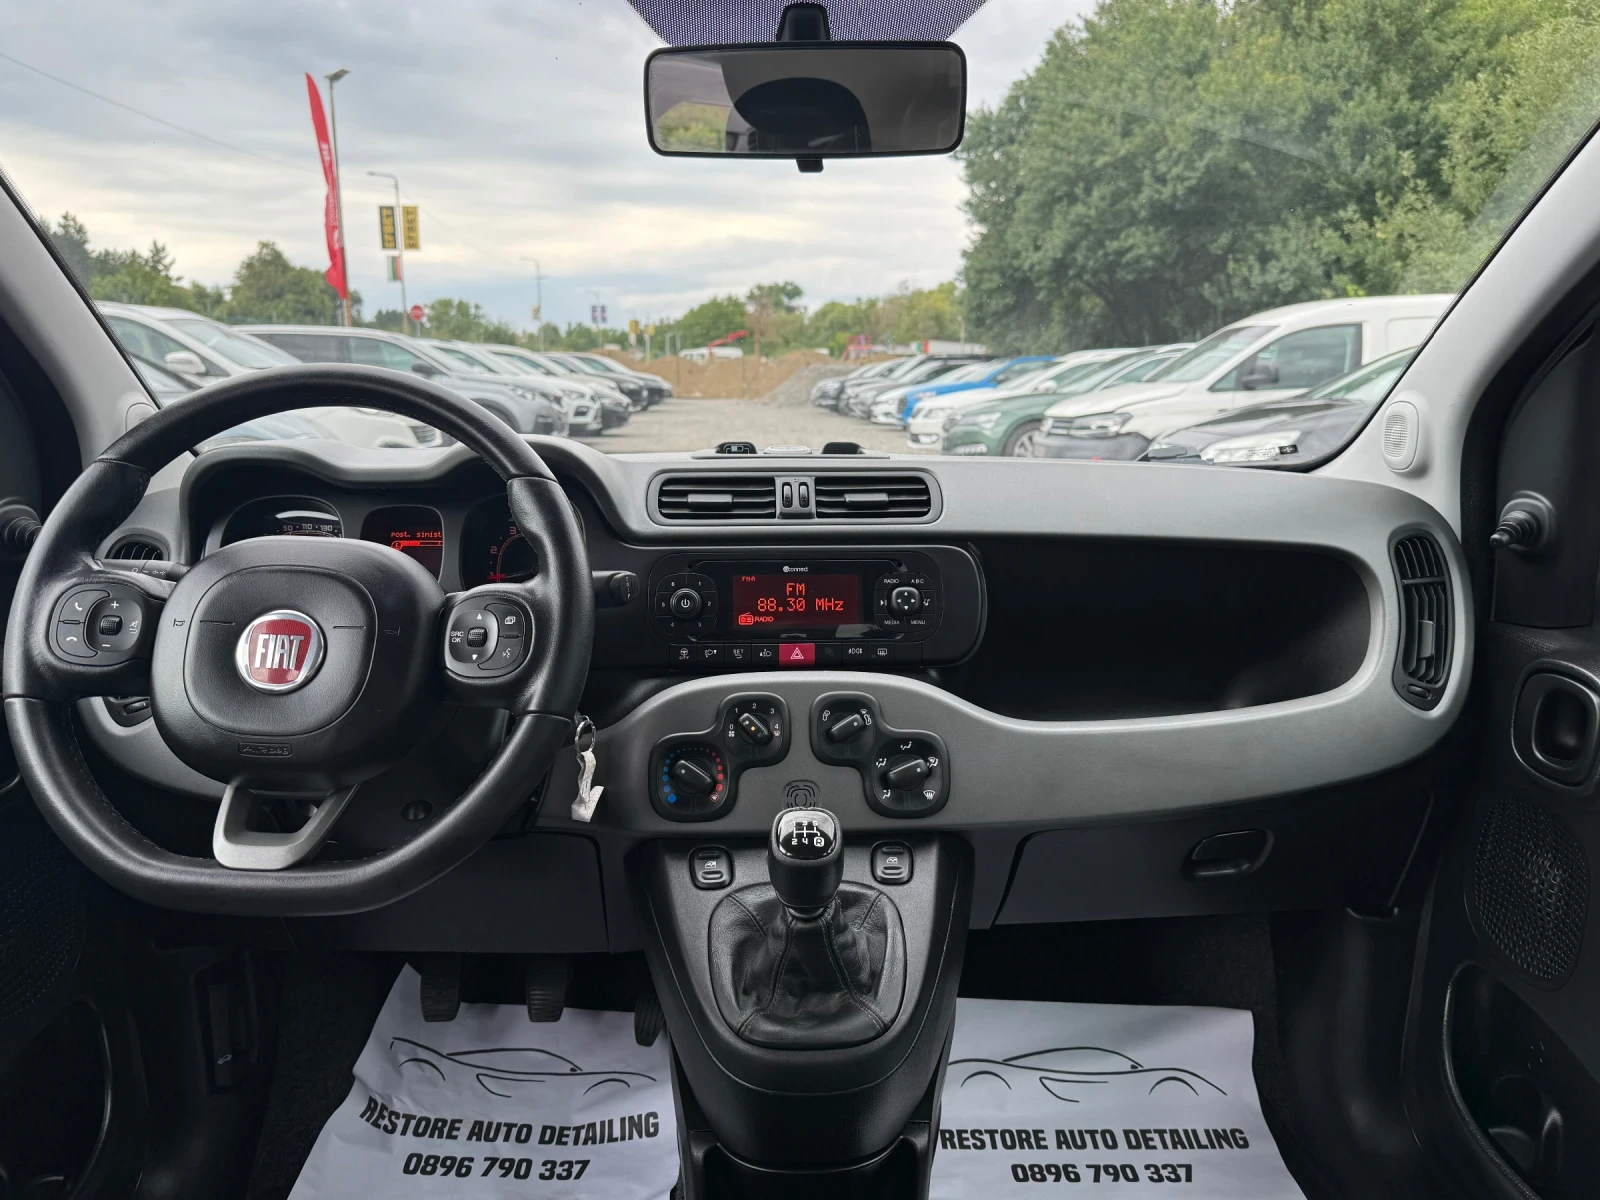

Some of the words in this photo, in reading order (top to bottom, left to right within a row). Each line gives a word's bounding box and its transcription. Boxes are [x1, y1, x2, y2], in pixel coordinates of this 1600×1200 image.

[509, 526, 517, 535] 3
[490, 545, 498, 554] 2
[786, 582, 806, 596] FM
[757, 597, 806, 612] 88.30
[815, 597, 844, 611] MHz
[254, 633, 305, 670] FIAT
[802, 837, 808, 845] 4
[359, 1096, 463, 1141] RESTORE
[466, 1120, 533, 1145] AUTO
[538, 1111, 660, 1146] DETAILING
[939, 1129, 1049, 1150] RESTORE
[1056, 1129, 1119, 1150] AUTO
[1122, 1128, 1250, 1150] DETAILING
[402, 1153, 475, 1178] 0896
[480, 1156, 533, 1180] 790
[538, 1159, 591, 1181] 337
[1010, 1163, 1081, 1183] 0896
[1085, 1164, 1140, 1183] 790
[1147, 1164, 1193, 1183] 337
